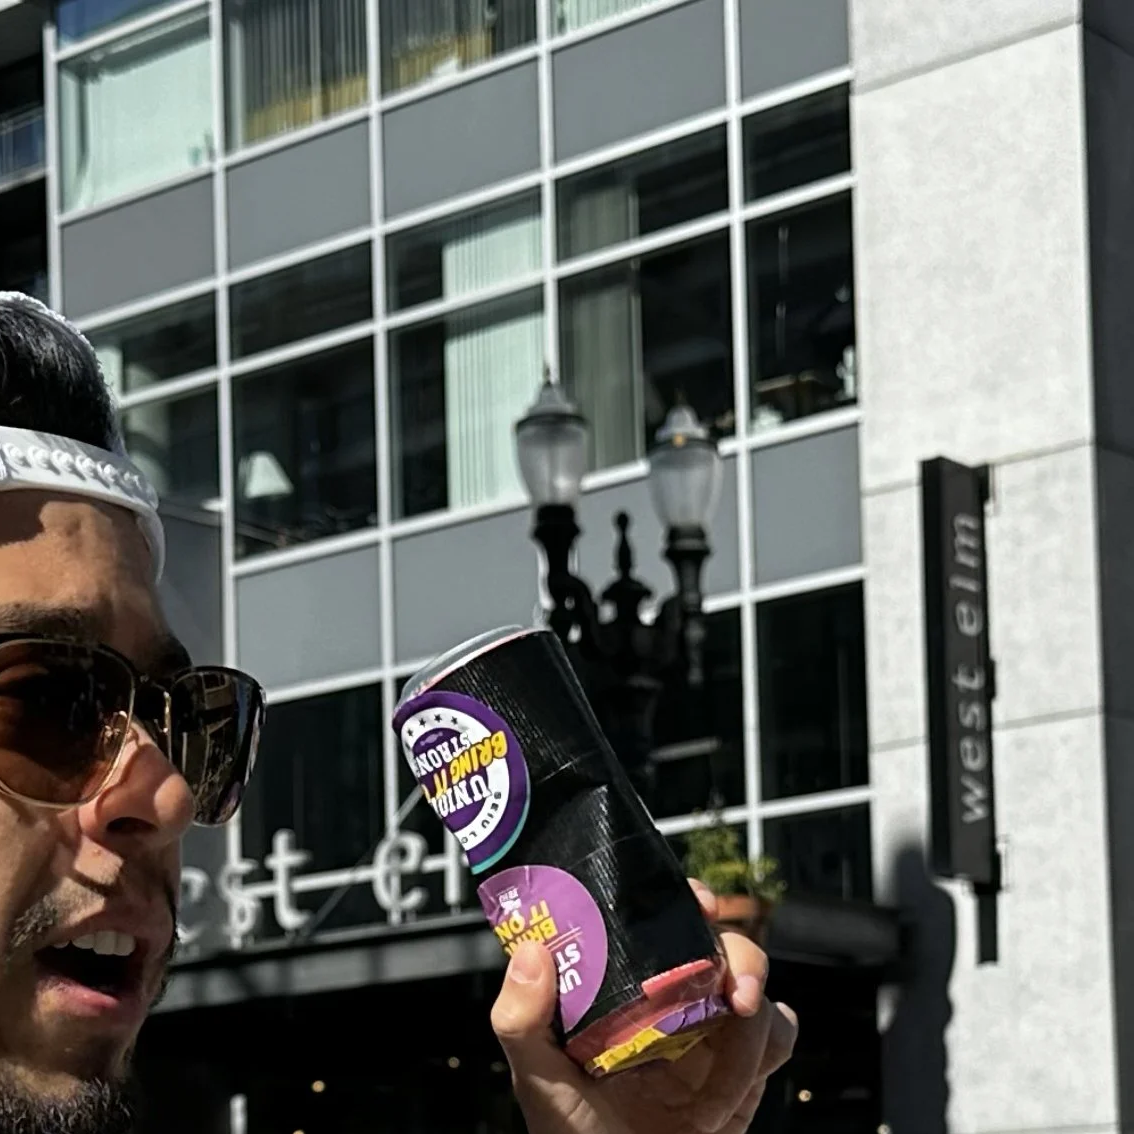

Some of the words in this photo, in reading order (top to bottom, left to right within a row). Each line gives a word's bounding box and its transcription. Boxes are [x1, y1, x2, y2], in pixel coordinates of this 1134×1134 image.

[948, 513, 983, 637] elm
[449, 731, 508, 785] BRING
[951, 664, 989, 824] west
[494, 914, 526, 943] ON
[529, 900, 552, 927] IT
